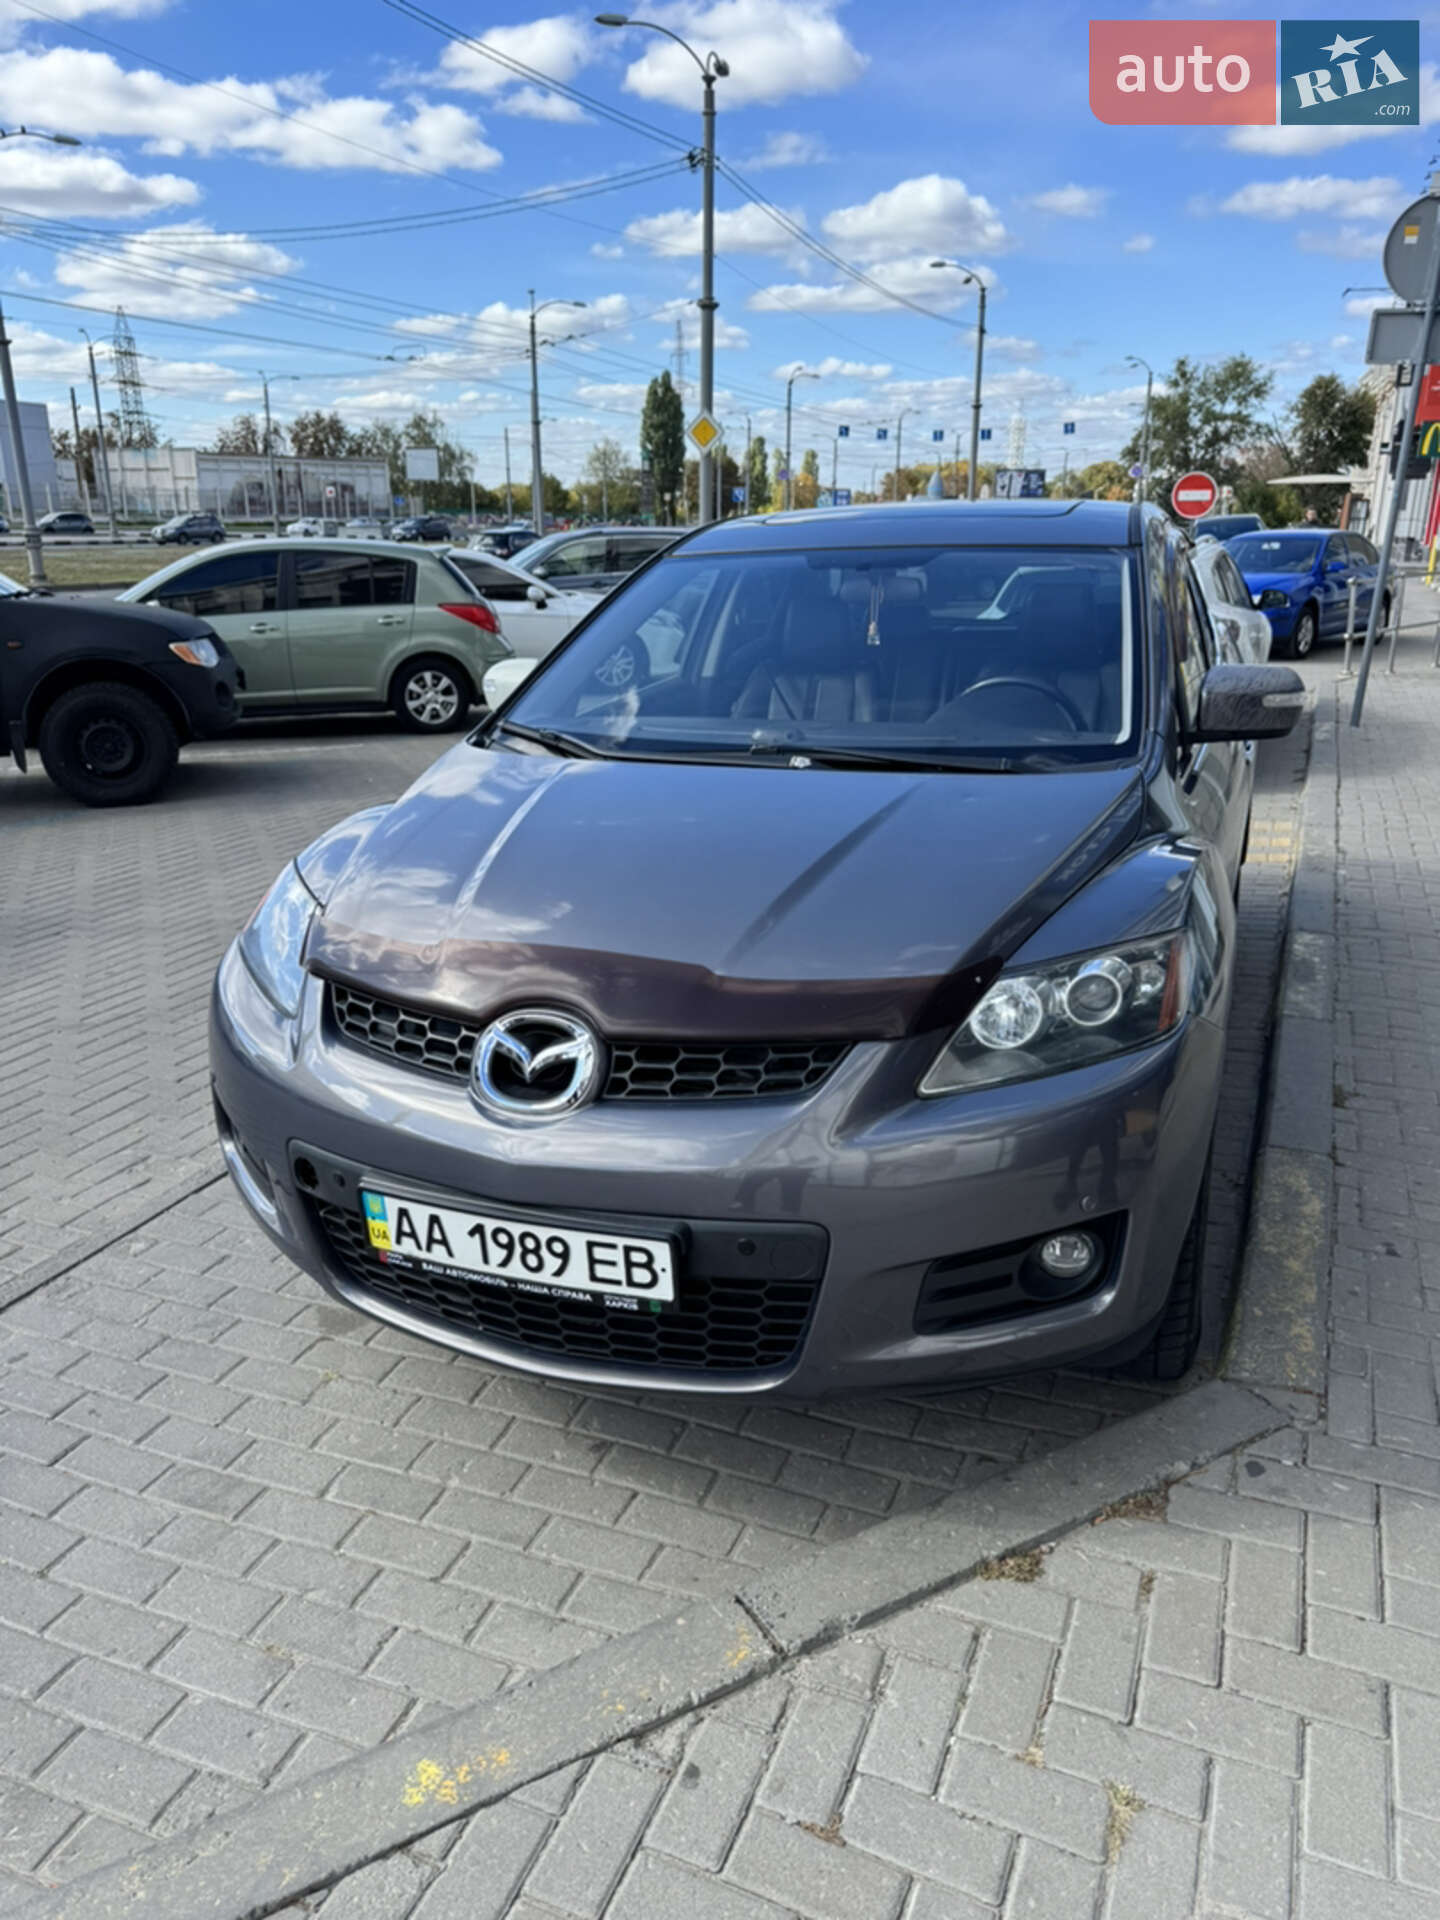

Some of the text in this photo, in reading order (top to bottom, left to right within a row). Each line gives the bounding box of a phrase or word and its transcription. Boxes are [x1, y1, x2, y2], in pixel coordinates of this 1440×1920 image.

[371, 1227, 390, 1241] UA
[395, 1206, 659, 1289] AA 1989 EB
